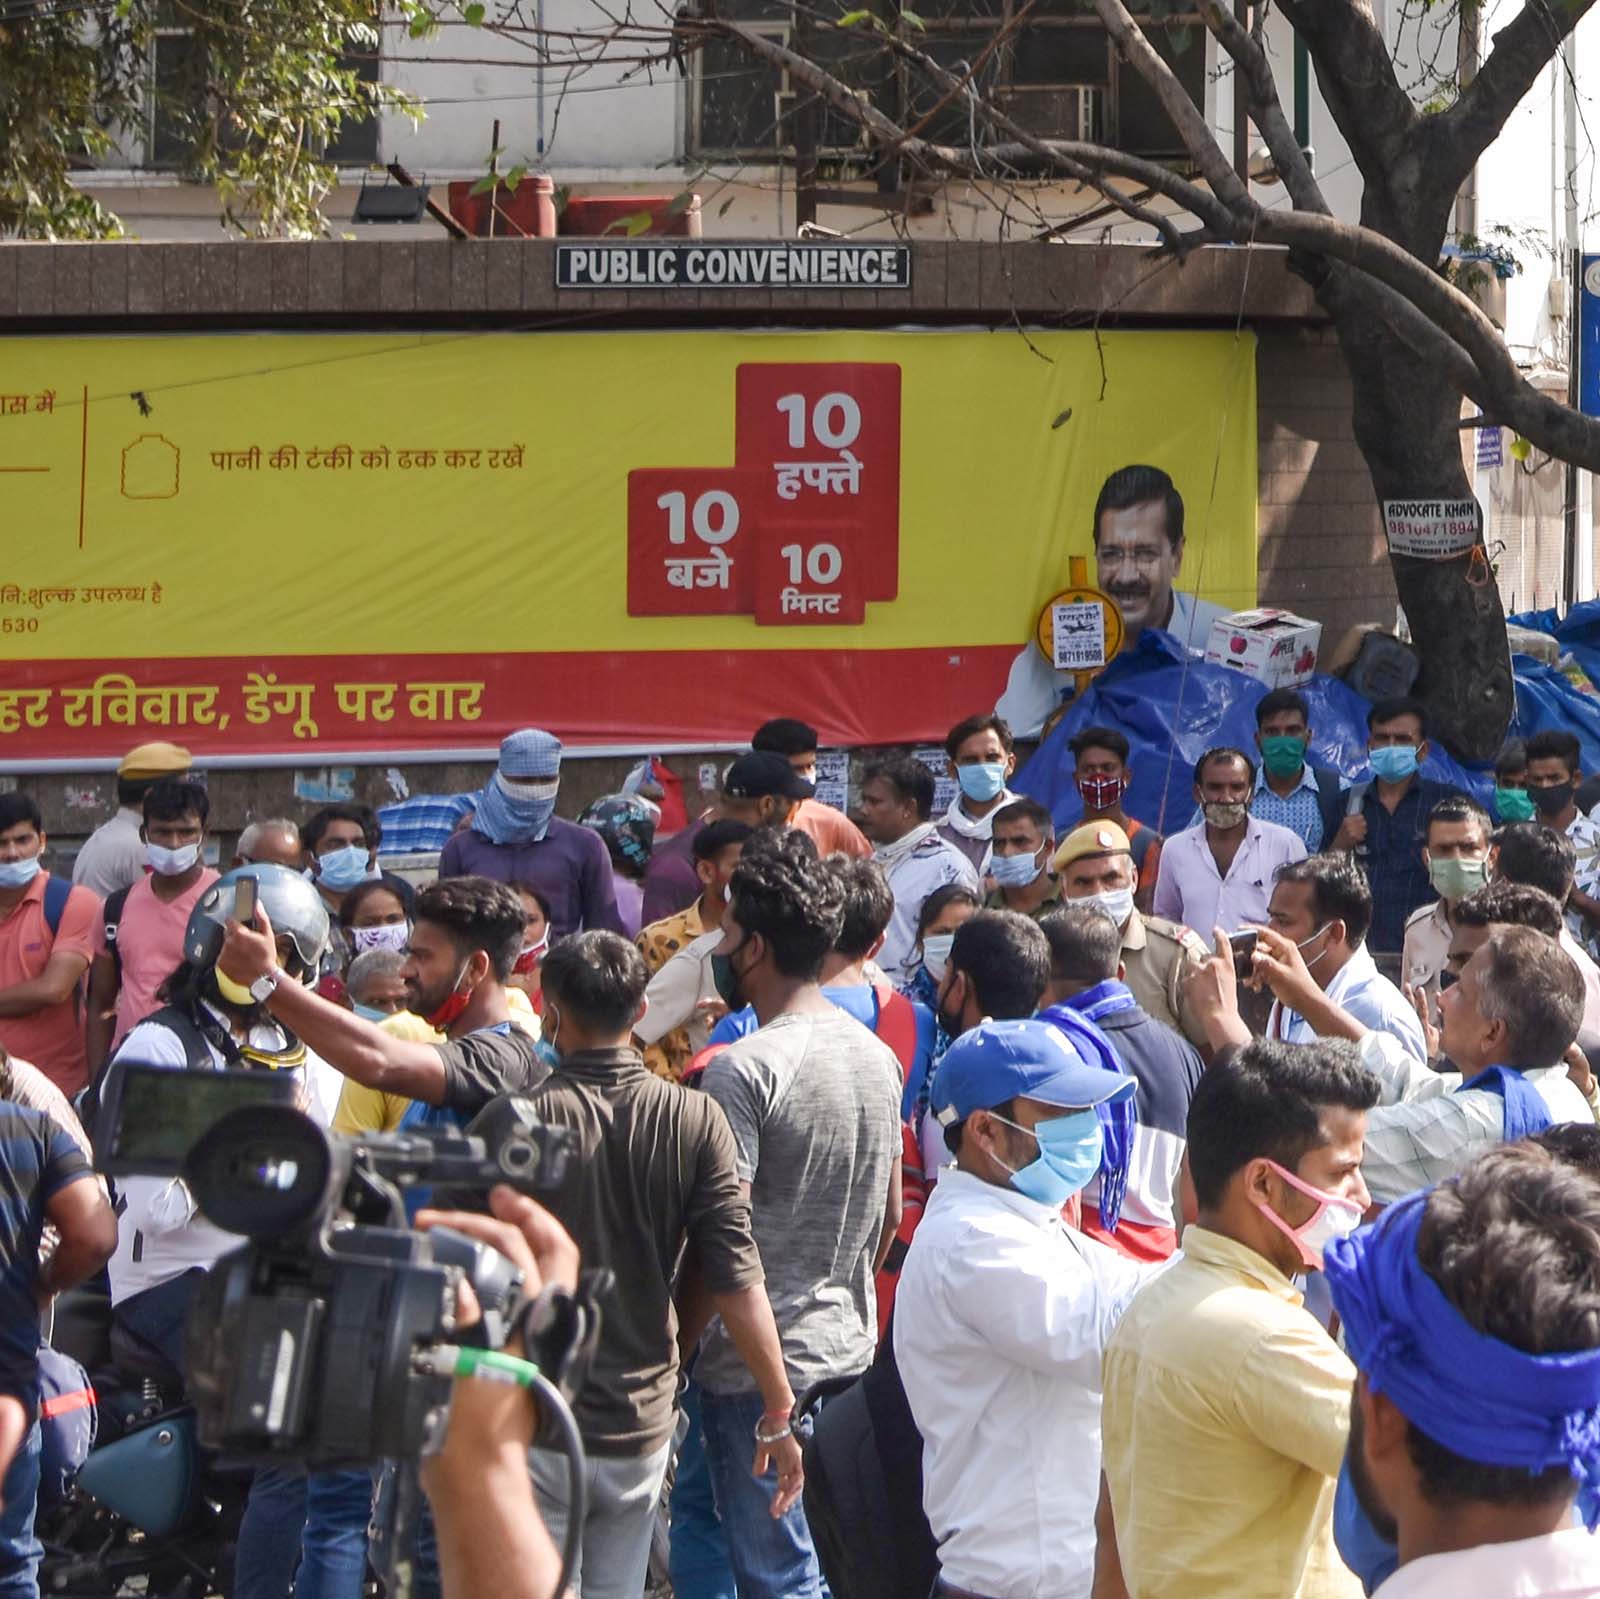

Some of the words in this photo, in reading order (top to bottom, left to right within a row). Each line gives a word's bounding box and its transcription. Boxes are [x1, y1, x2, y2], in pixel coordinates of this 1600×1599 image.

[569, 250, 678, 283] PUBLIC
[685, 250, 899, 283] CONVENIENCE
[776, 392, 862, 449] 10
[210, 446, 262, 471] पानी
[268, 444, 301, 471] की
[306, 444, 354, 471] टंकी
[360, 445, 392, 470] को
[398, 449, 437, 470] ढक
[444, 449, 482, 470] कर
[488, 444, 526, 470] रखें
[773, 450, 864, 500] हफ्ते
[657, 490, 740, 545] 10
[1388, 503, 1441, 518] ADVOCATE
[1445, 502, 1474, 518] KHAN
[663, 547, 735, 590] बजे
[780, 543, 842, 585] 10
[151, 581, 163, 604] है
[780, 587, 842, 614] मिनट
[0, 688, 53, 733] हर
[60, 673, 231, 731] रविवार,
[242, 672, 320, 738] डेंगू
[334, 683, 399, 722] पर
[405, 681, 486, 721] वार
